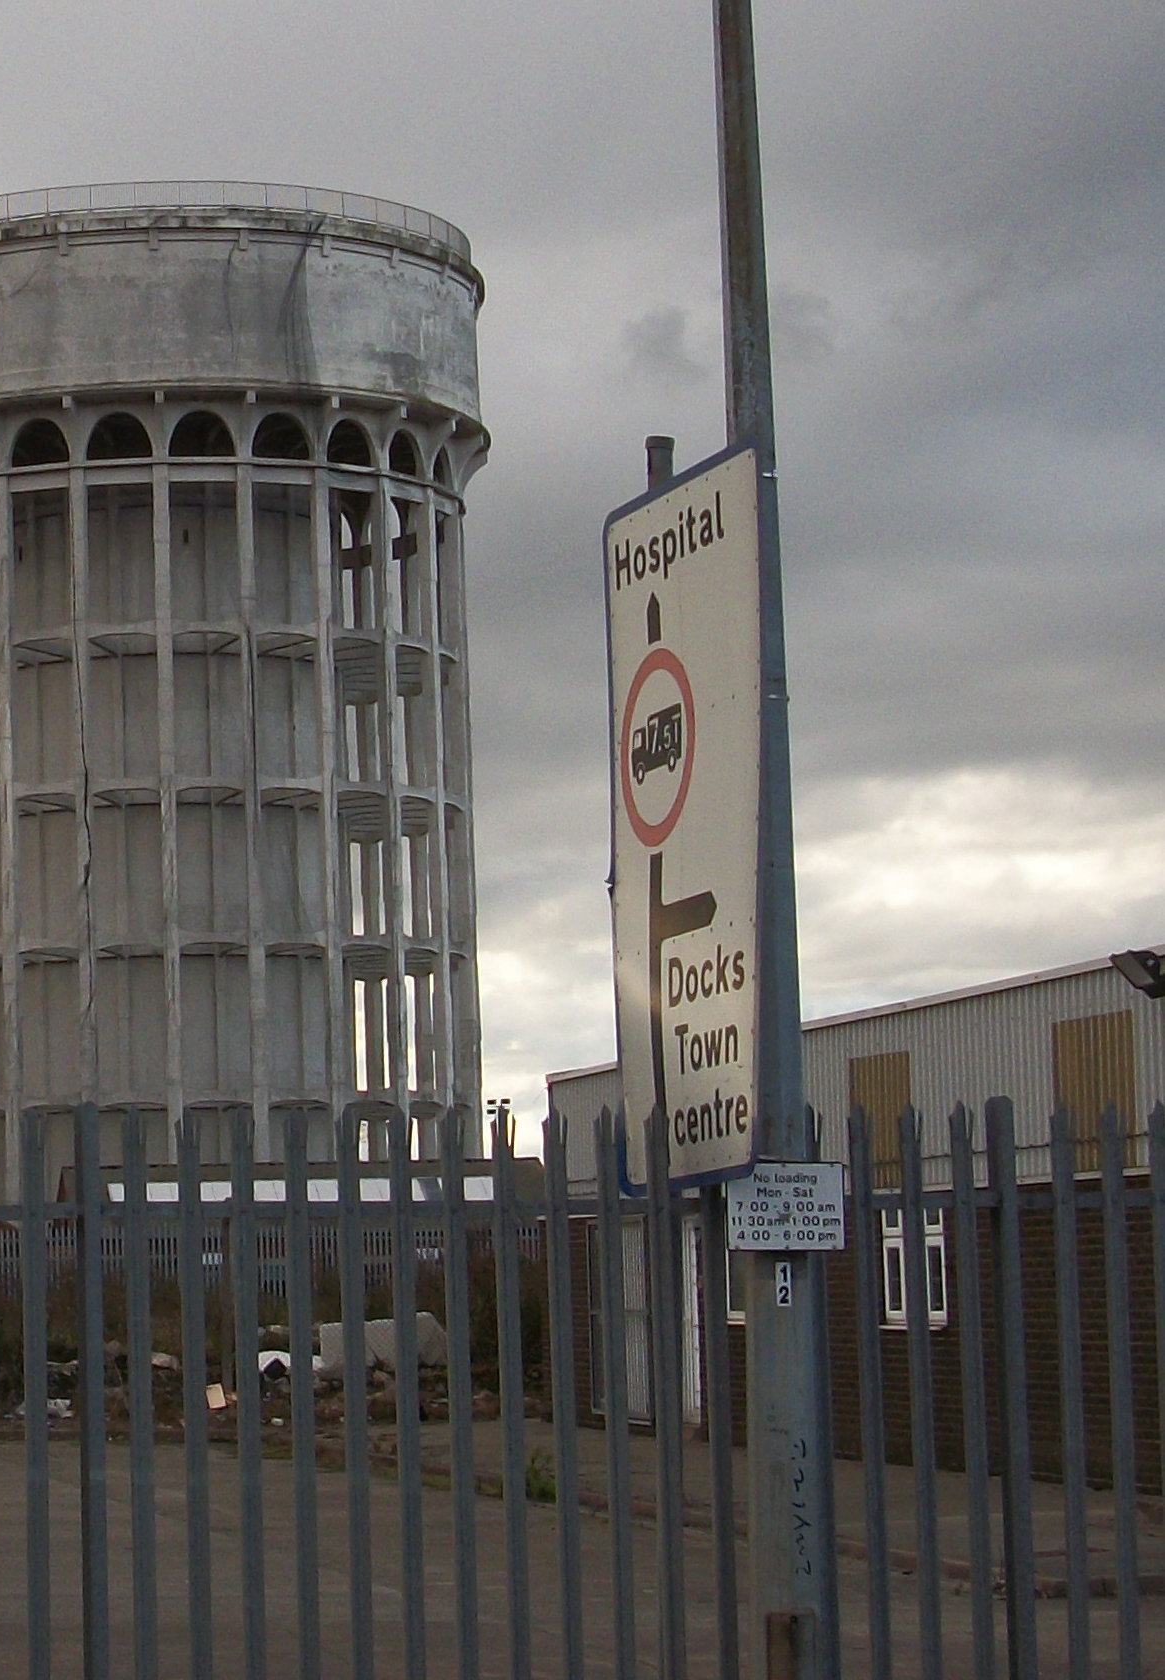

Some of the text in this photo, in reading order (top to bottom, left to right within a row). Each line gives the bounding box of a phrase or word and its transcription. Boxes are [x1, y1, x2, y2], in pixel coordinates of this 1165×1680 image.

[615, 490, 725, 591] Hospital
[668, 943, 745, 1008] Docks
[674, 1023, 739, 1075] Town
[673, 1087, 748, 1147] centre
[753, 1173, 818, 1186] No loading
[756, 1187, 782, 1198] Mon
[792, 1187, 814, 1198] Sat
[818, 1203, 836, 1212] am
[766, 1217, 785, 1227] am
[822, 1217, 841, 1228] pm
[818, 1232, 837, 1242] pm
